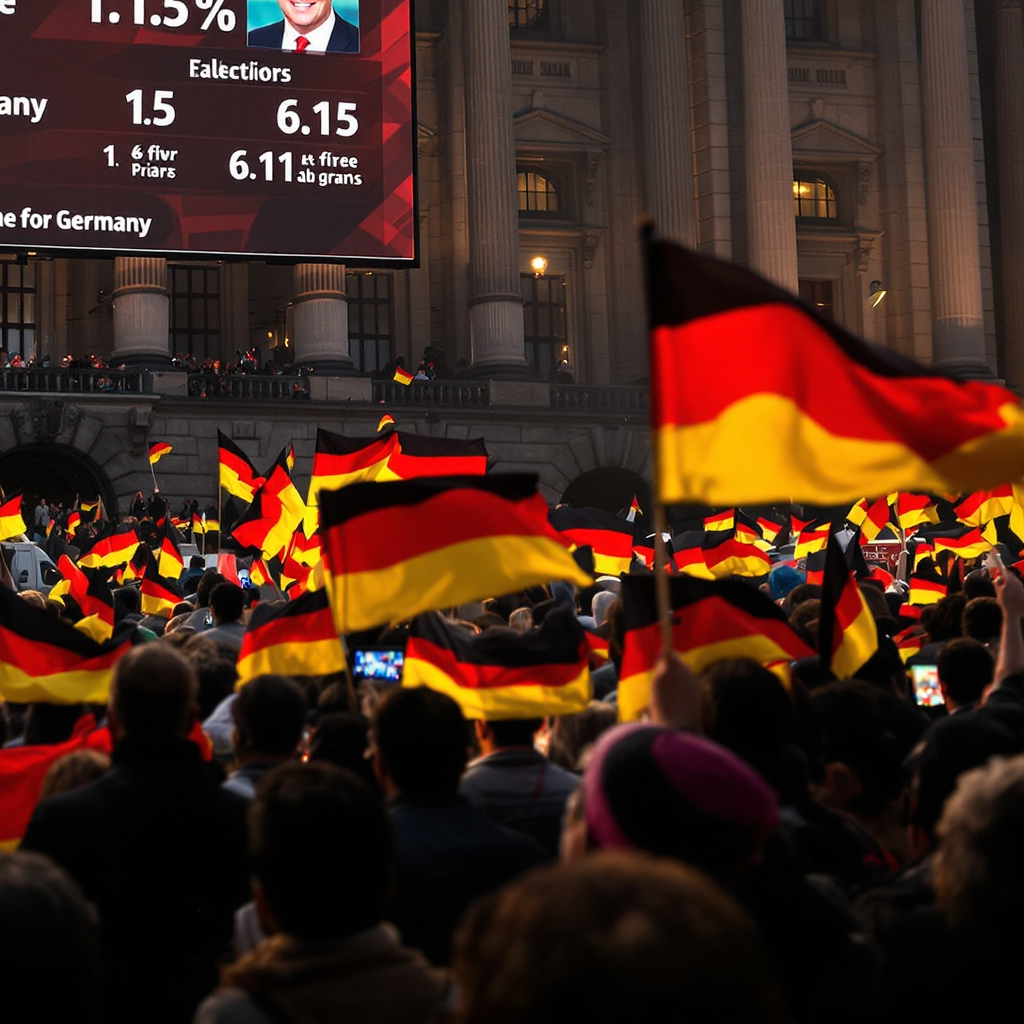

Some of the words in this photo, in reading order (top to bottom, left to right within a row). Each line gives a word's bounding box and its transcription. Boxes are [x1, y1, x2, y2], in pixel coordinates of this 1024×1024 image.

[125, 88, 176, 127] 1.5
[276, 98, 359, 137] 6.15
[228, 149, 293, 183] 6.11
[19, 206, 53, 230] for
[56, 209, 153, 238] Germany
